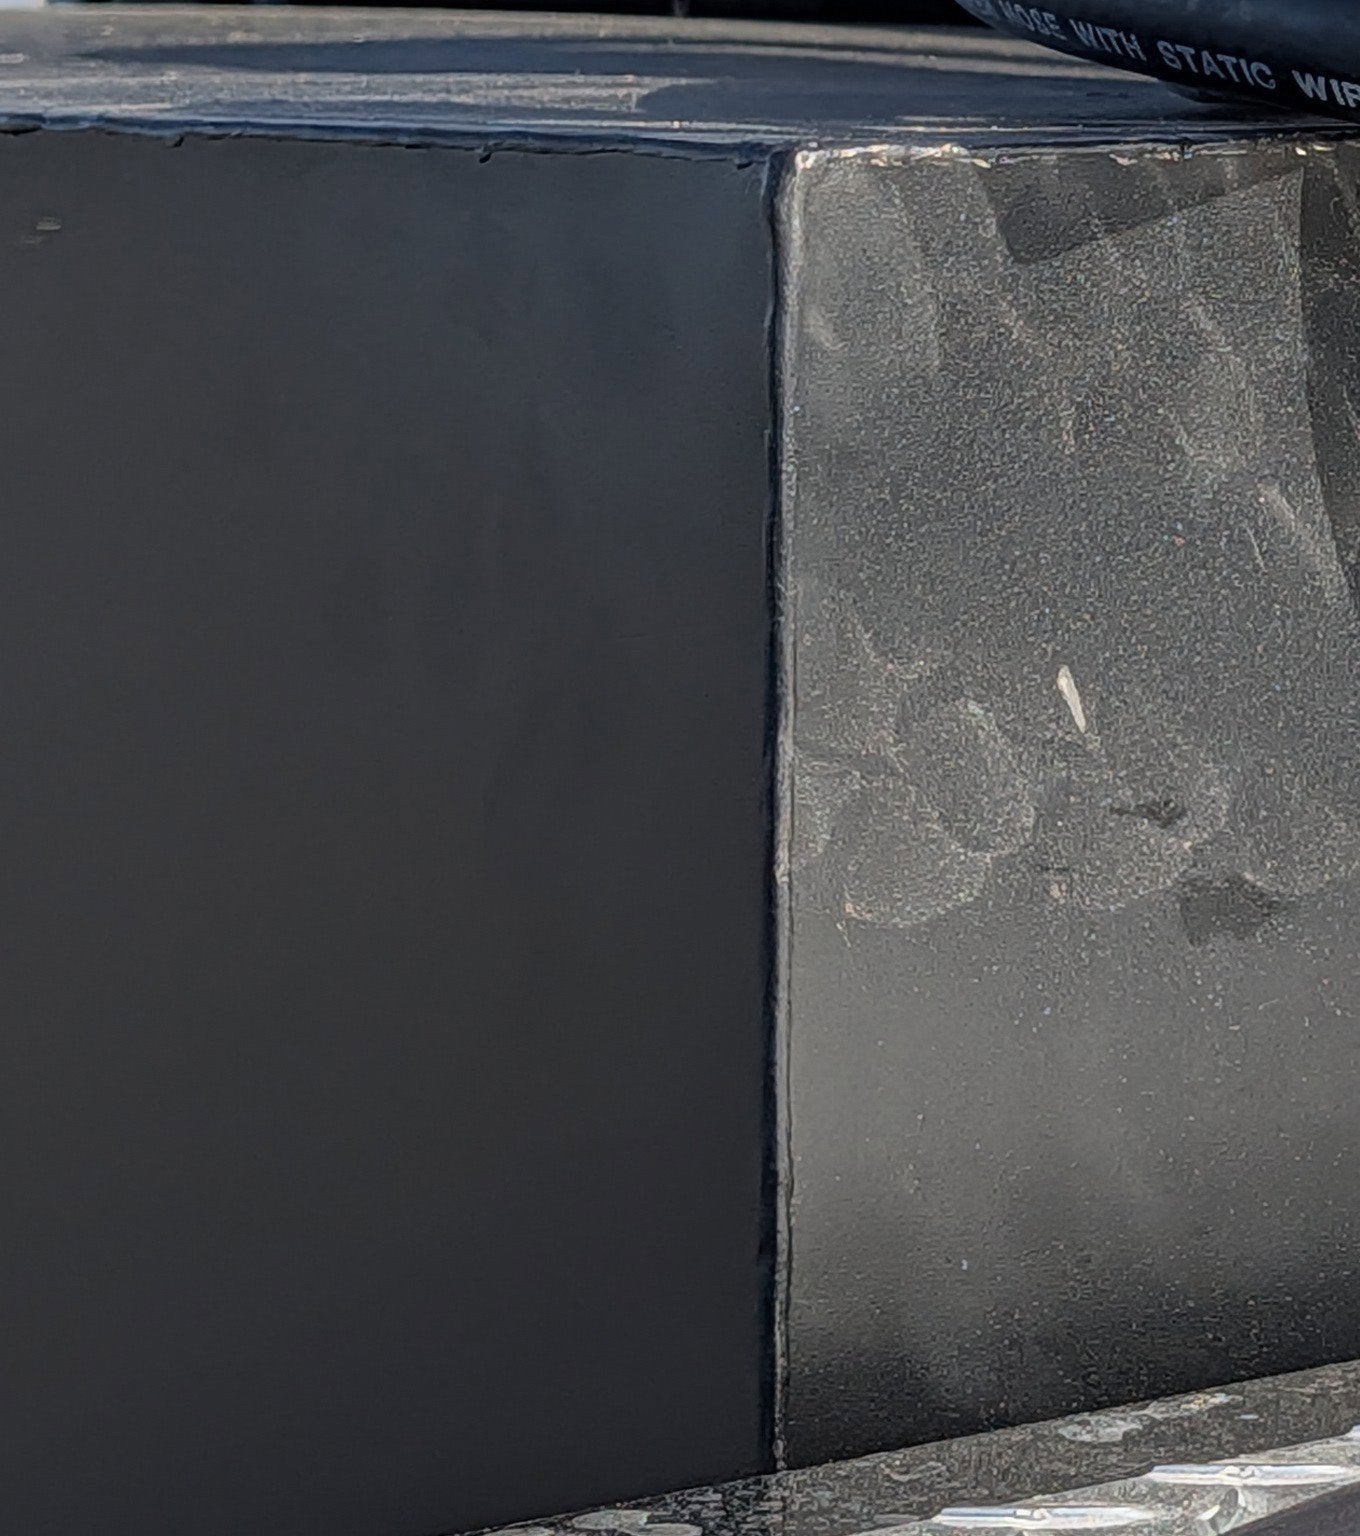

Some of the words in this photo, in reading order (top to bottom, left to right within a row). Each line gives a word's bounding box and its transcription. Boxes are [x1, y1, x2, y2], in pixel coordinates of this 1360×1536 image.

[998, 0, 1067, 41] HOSE
[1068, 18, 1148, 62] WITH
[1156, 40, 1277, 91] STATIC
